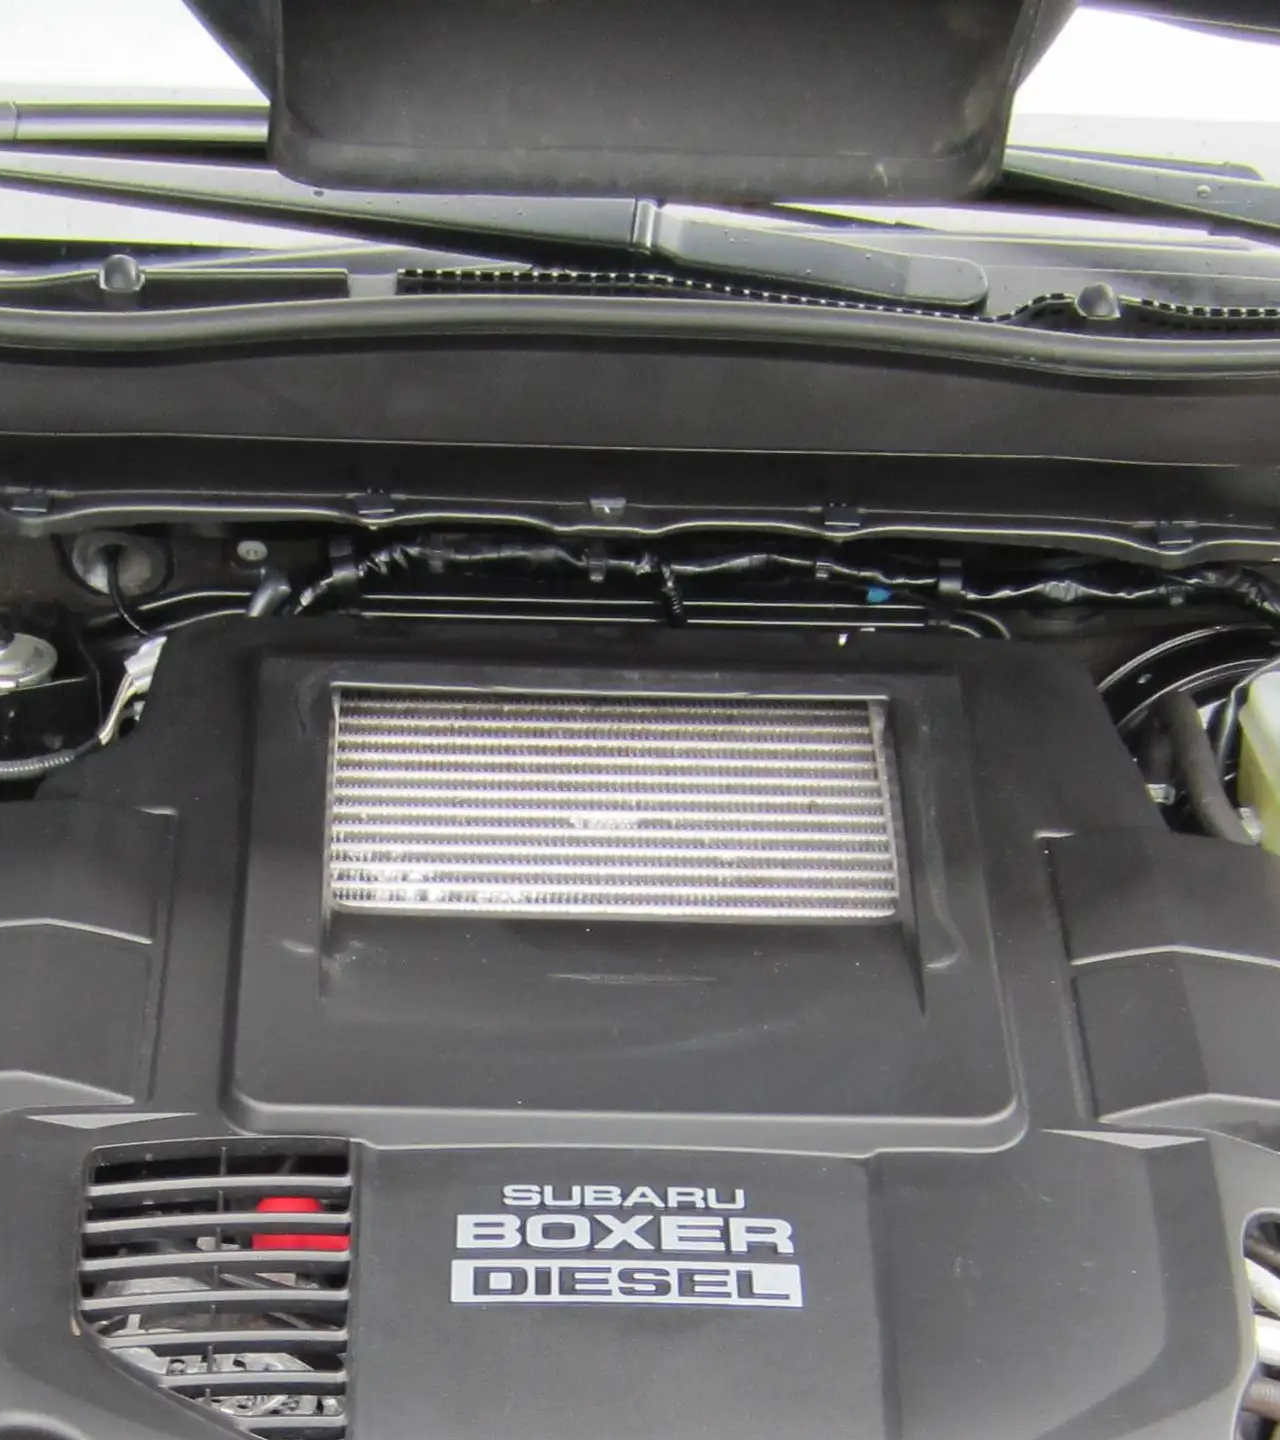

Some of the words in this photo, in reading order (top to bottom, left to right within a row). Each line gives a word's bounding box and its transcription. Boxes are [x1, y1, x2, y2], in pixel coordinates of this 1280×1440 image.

[502, 1184, 746, 1210] SUBARU
[455, 1213, 795, 1255] BOXER
[472, 1264, 792, 1301] DIESEL
